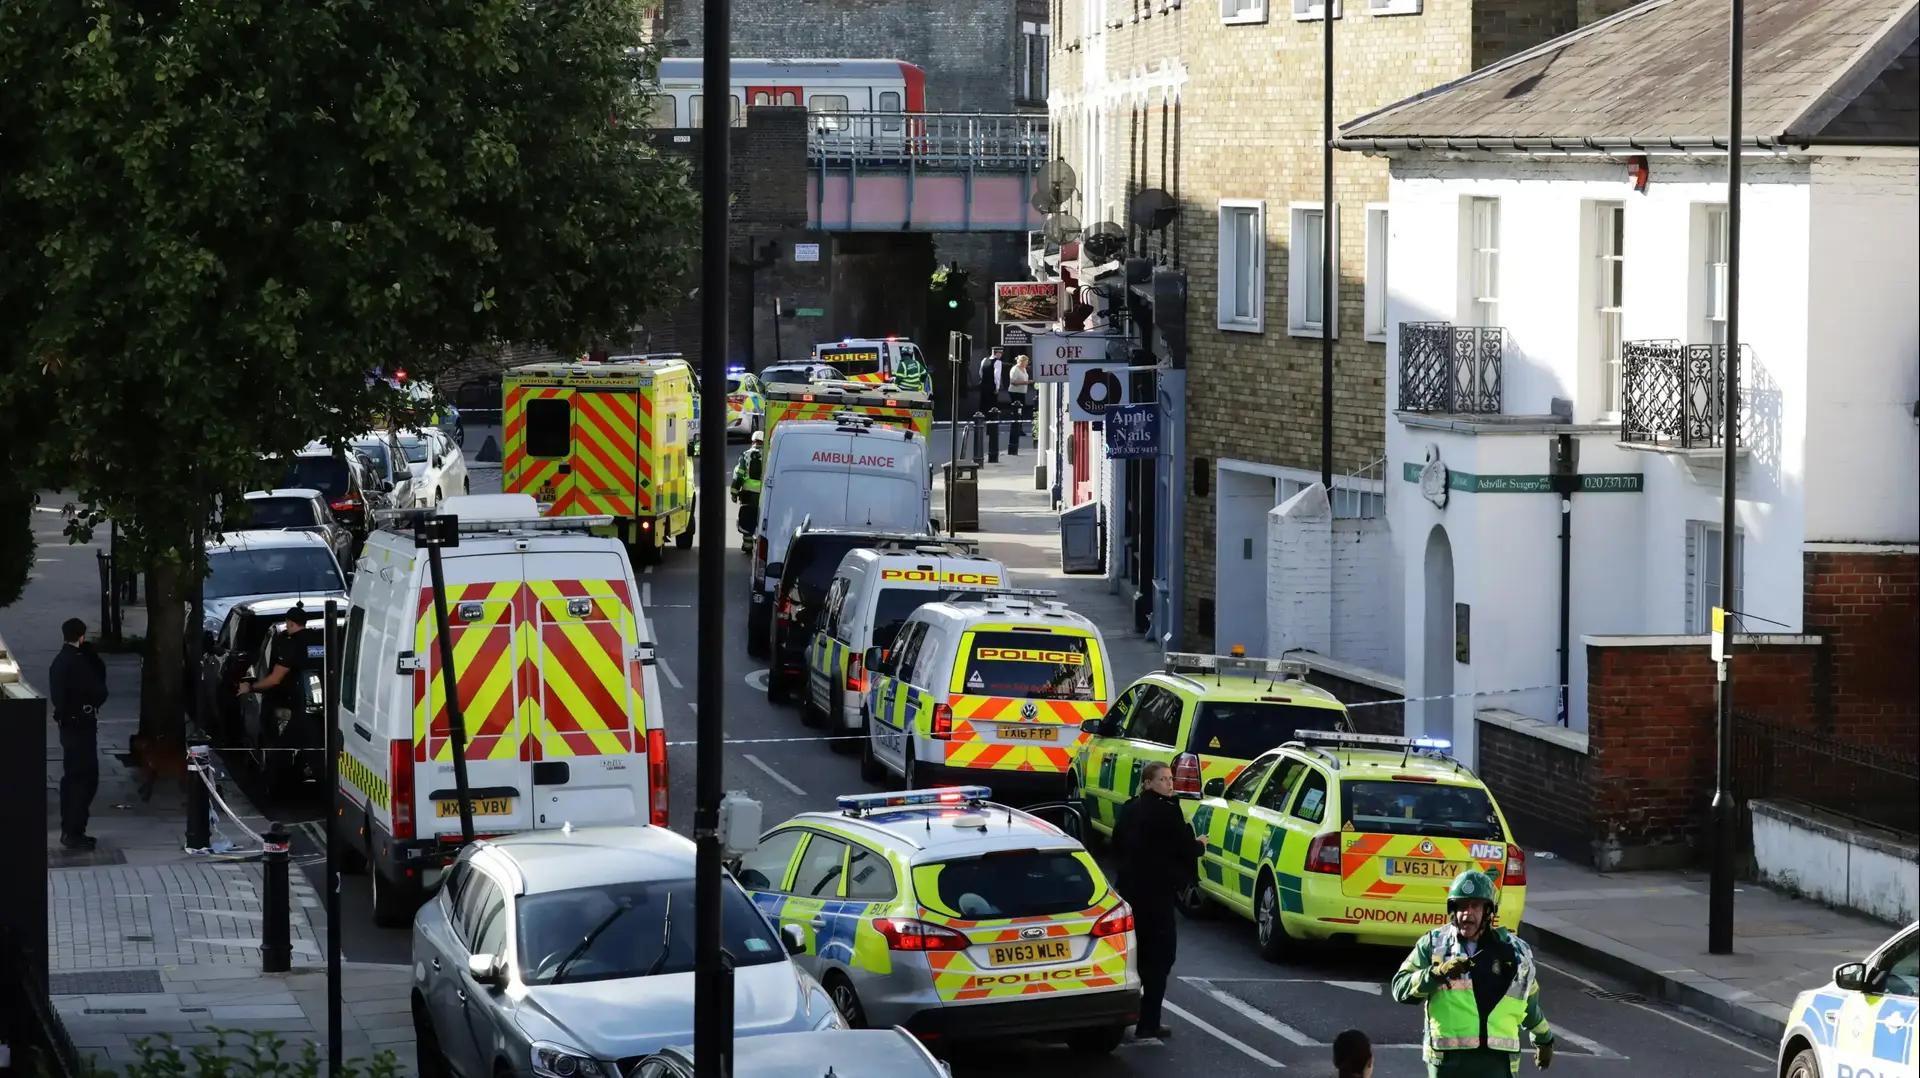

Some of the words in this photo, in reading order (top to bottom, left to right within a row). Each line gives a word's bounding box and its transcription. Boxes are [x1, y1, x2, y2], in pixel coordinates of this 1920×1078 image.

[1000, 285, 1055, 296] KEBABS
[822, 353, 877, 361] POLICE
[1056, 346, 1082, 359] OFF
[1084, 400, 1107, 411] Sho
[1112, 410, 1154, 426] Apple
[1116, 428, 1151, 441] Nails
[811, 451, 895, 468] AMBULANCE
[1477, 479, 1507, 488] Ashville
[1509, 479, 1539, 490] Surgery
[881, 569, 999, 585] POLICE
[980, 649, 1083, 664] POLICE
[1030, 728, 1052, 739] FTP
[442, 800, 477, 815] MX6
[483, 799, 508, 814] VBV
[1471, 844, 1503, 859] NHS
[1395, 861, 1429, 875] LV63
[1432, 863, 1458, 877] LKY
[869, 903, 891, 916] BLK
[1345, 906, 1407, 923] LONDON
[995, 945, 1034, 963] BV63
[1037, 942, 1065, 959] WLR
[977, 967, 1092, 986] POLICE
